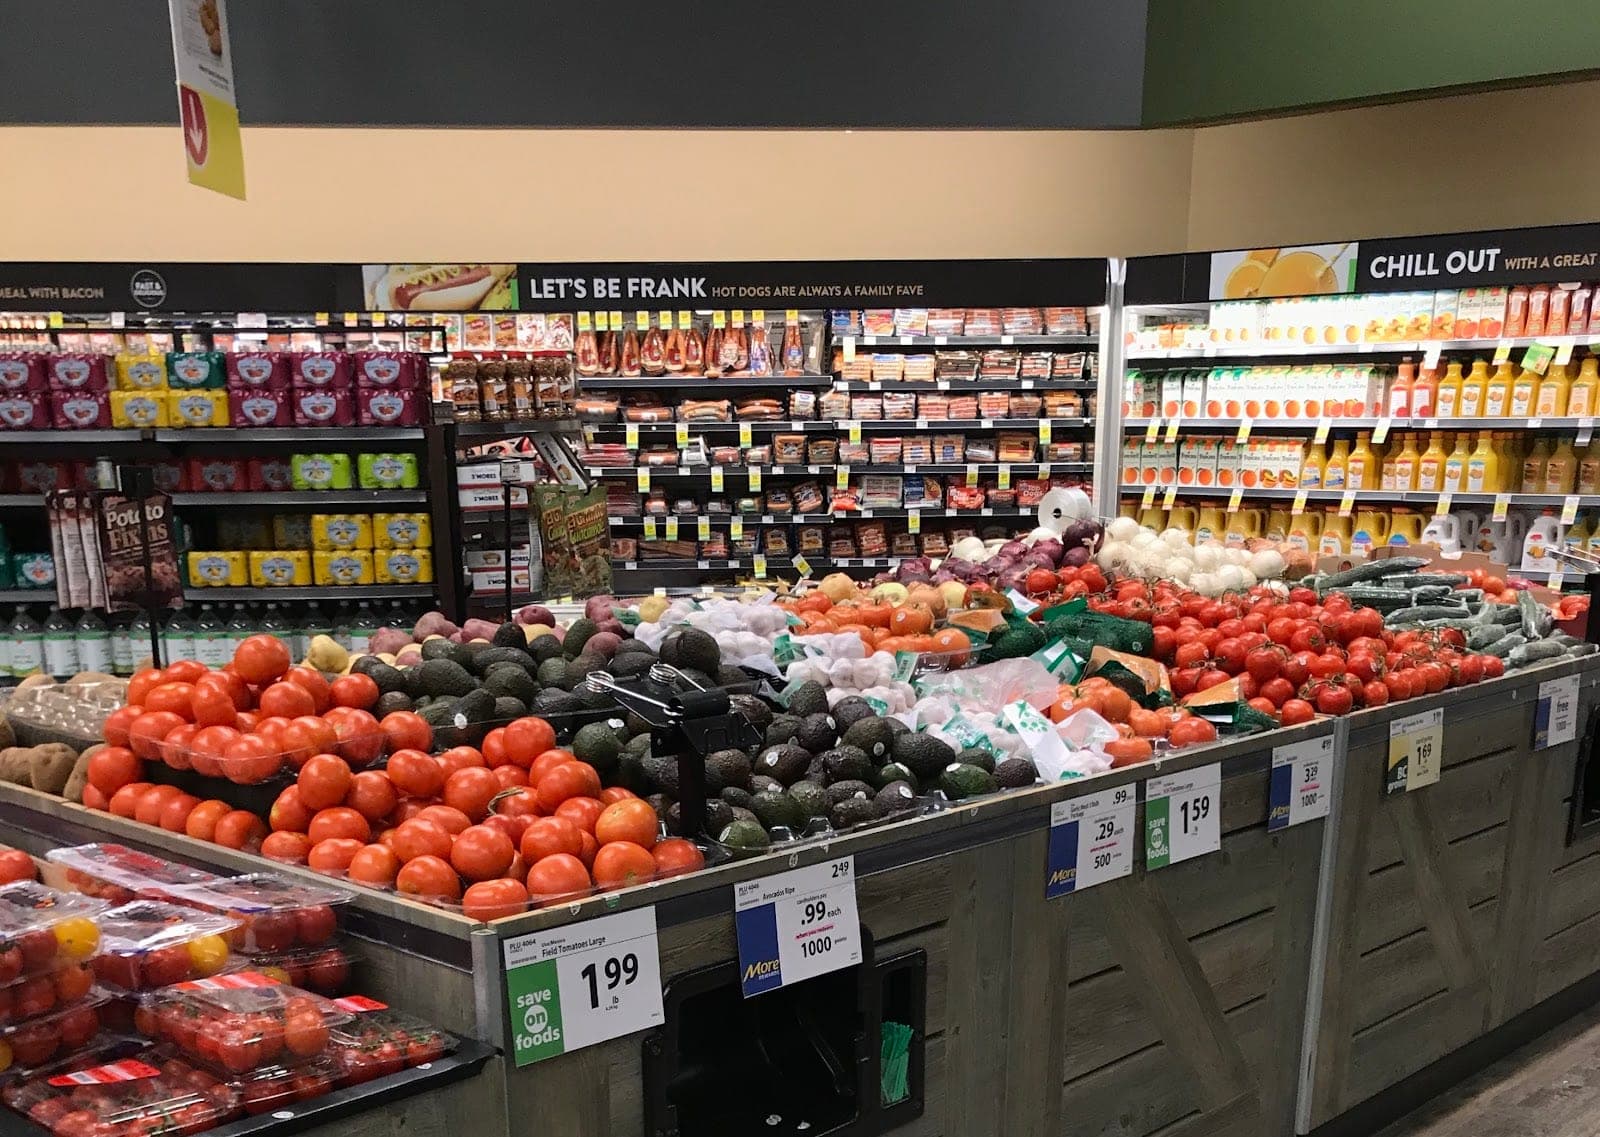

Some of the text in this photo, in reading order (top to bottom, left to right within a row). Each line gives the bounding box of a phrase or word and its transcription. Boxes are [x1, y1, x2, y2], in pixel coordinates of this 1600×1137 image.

[1370, 248, 1598, 280] CHILL OUT WITH A GREAT
[29, 288, 60, 299] WITH
[62, 287, 105, 299] BACON
[530, 277, 922, 300] LET'S BE FRANK HOT DOGS ARE ALWAYS A FAMILY FAVE
[1095, 821, 1114, 841] .29
[1148, 817, 1167, 831] save
[1093, 852, 1111, 869] 500
[1146, 844, 1169, 861] foods
[762, 890, 785, 901] Avocados
[784, 887, 796, 897] Ripe
[801, 900, 826, 926] .99
[827, 907, 842, 918] each
[522, 938, 536, 947] 4064
[542, 936, 606, 958] Field Tomatoes Large
[800, 936, 832, 959] 1000
[743, 959, 779, 983] More
[516, 989, 552, 1010] save
[612, 996, 620, 1005] lb
[525, 1011, 547, 1027] on
[515, 1026, 561, 1052] foods
